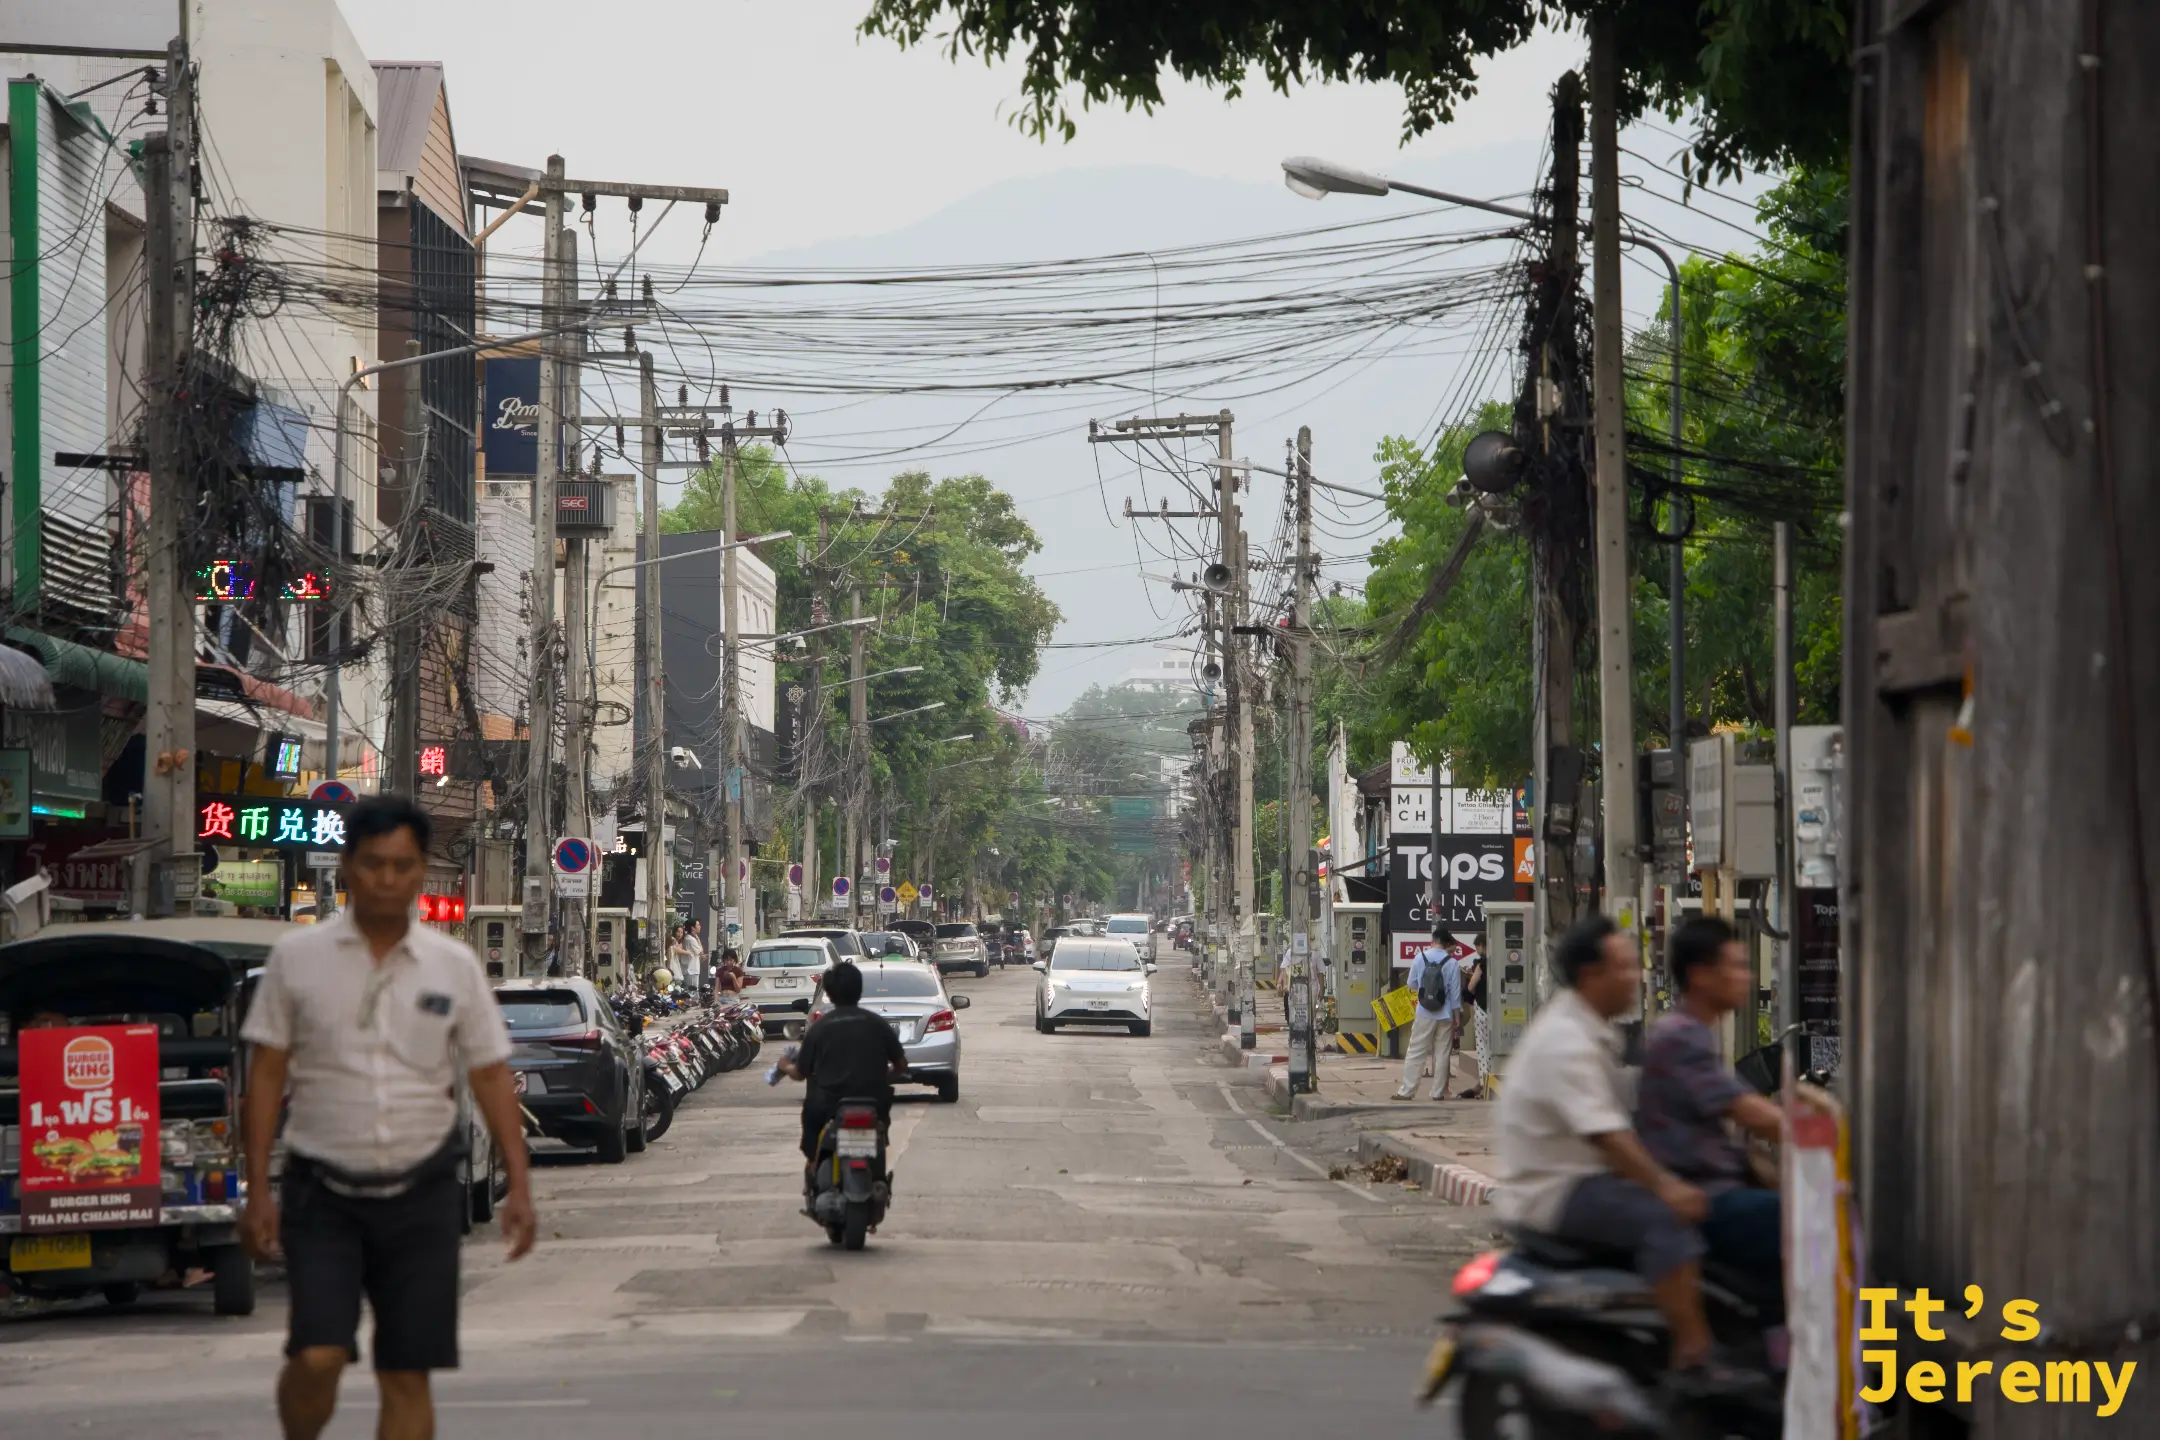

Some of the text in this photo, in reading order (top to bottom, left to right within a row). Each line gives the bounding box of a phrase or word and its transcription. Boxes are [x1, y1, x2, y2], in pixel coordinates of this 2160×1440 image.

[561, 499, 585, 508] SEC
[198, 801, 346, 845] 货币兑换
[1396, 845, 1505, 890] Tops
[1415, 893, 1482, 907] WINE
[67, 1053, 110, 1063] BURGER
[67, 1063, 110, 1077] KING
[50, 1193, 131, 1208] BURGER KING
[28, 1214, 55, 1225] THA
[80, 1209, 128, 1223] CHIANG
[128, 1208, 153, 1220] MAI
